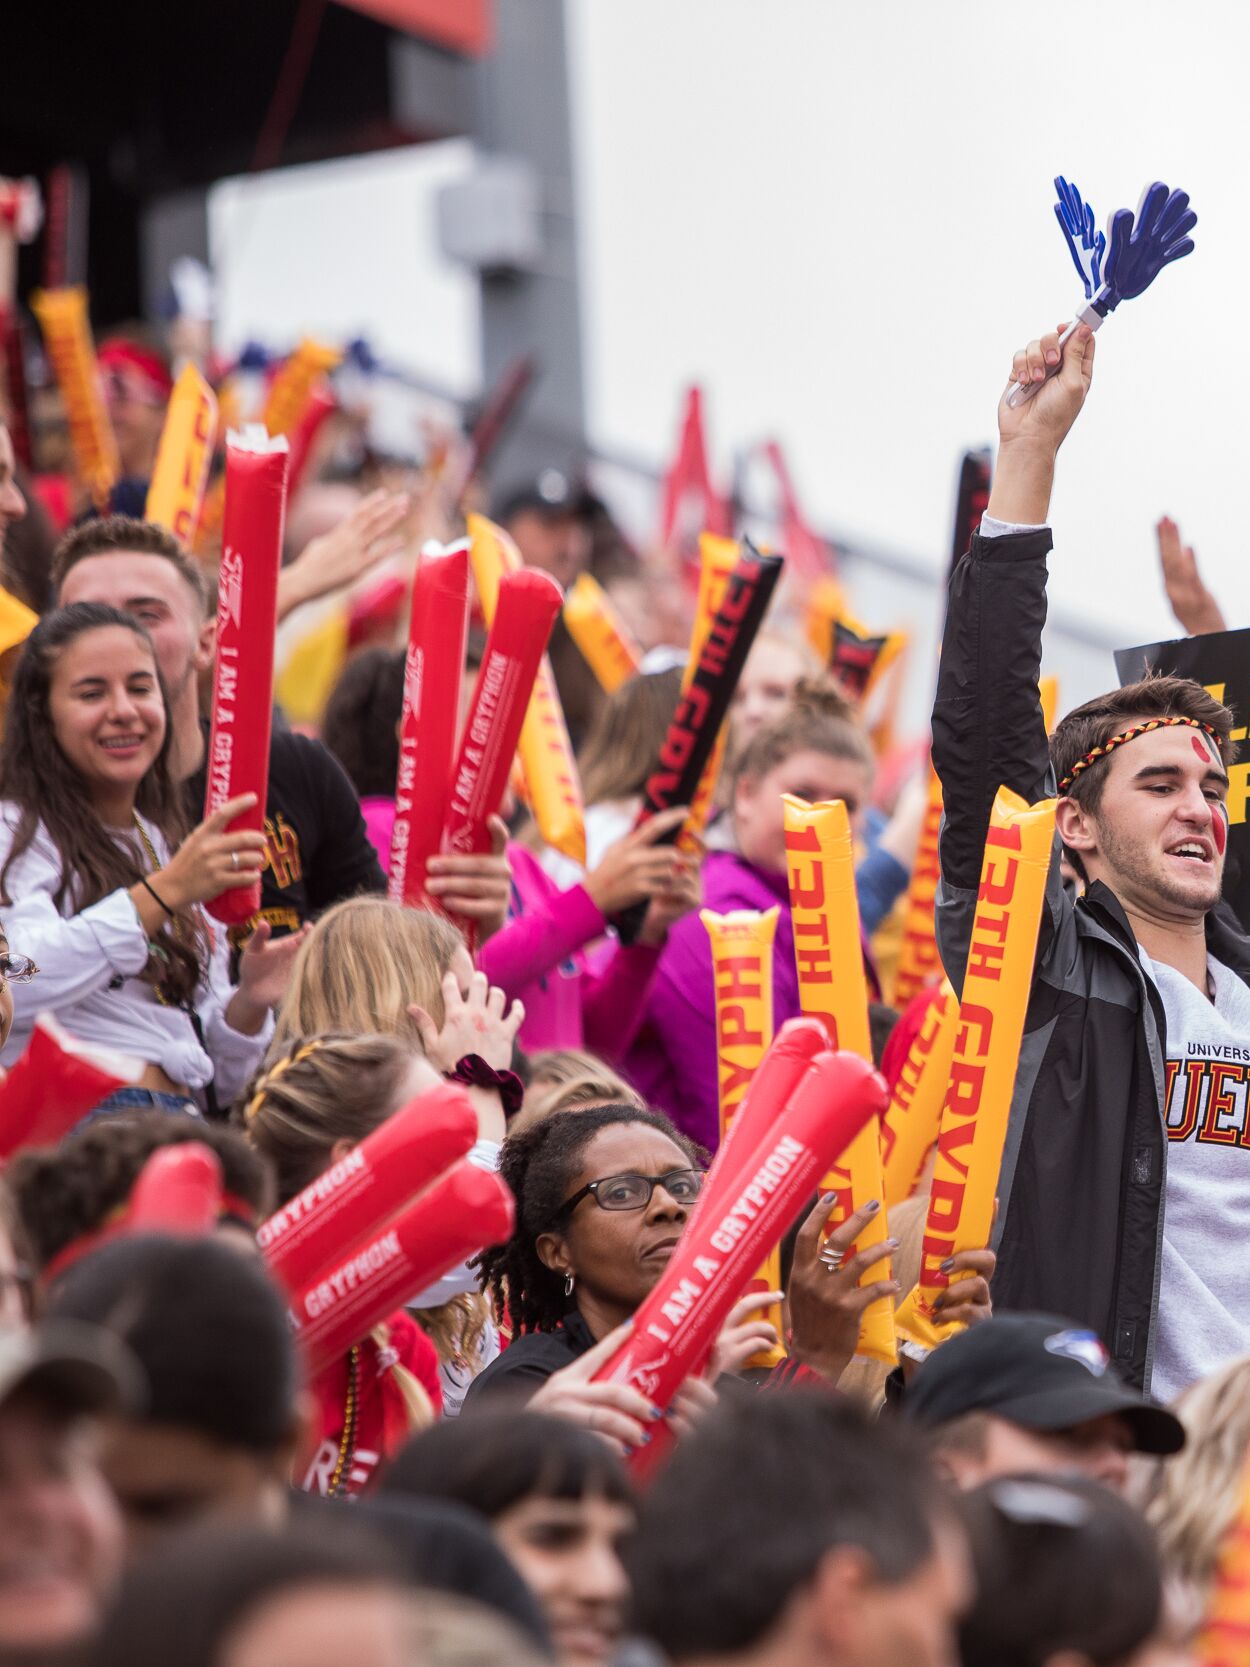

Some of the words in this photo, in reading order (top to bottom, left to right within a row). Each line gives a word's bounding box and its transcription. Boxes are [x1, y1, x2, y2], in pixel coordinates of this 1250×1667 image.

[217, 708, 234, 724] A
[218, 664, 237, 701] AM
[455, 766, 476, 801] AM
[464, 747, 482, 762] A
[784, 825, 833, 984] 13TH
[967, 822, 1022, 983] 13TH
[716, 956, 763, 1141] YPH
[256, 1147, 366, 1247] GRYPHON
[647, 1323, 669, 1342] I
[661, 1278, 701, 1326] AM
[693, 1254, 720, 1279] A
[710, 1134, 805, 1254] GRYPHON
[304, 1230, 401, 1318] GRYPHON
